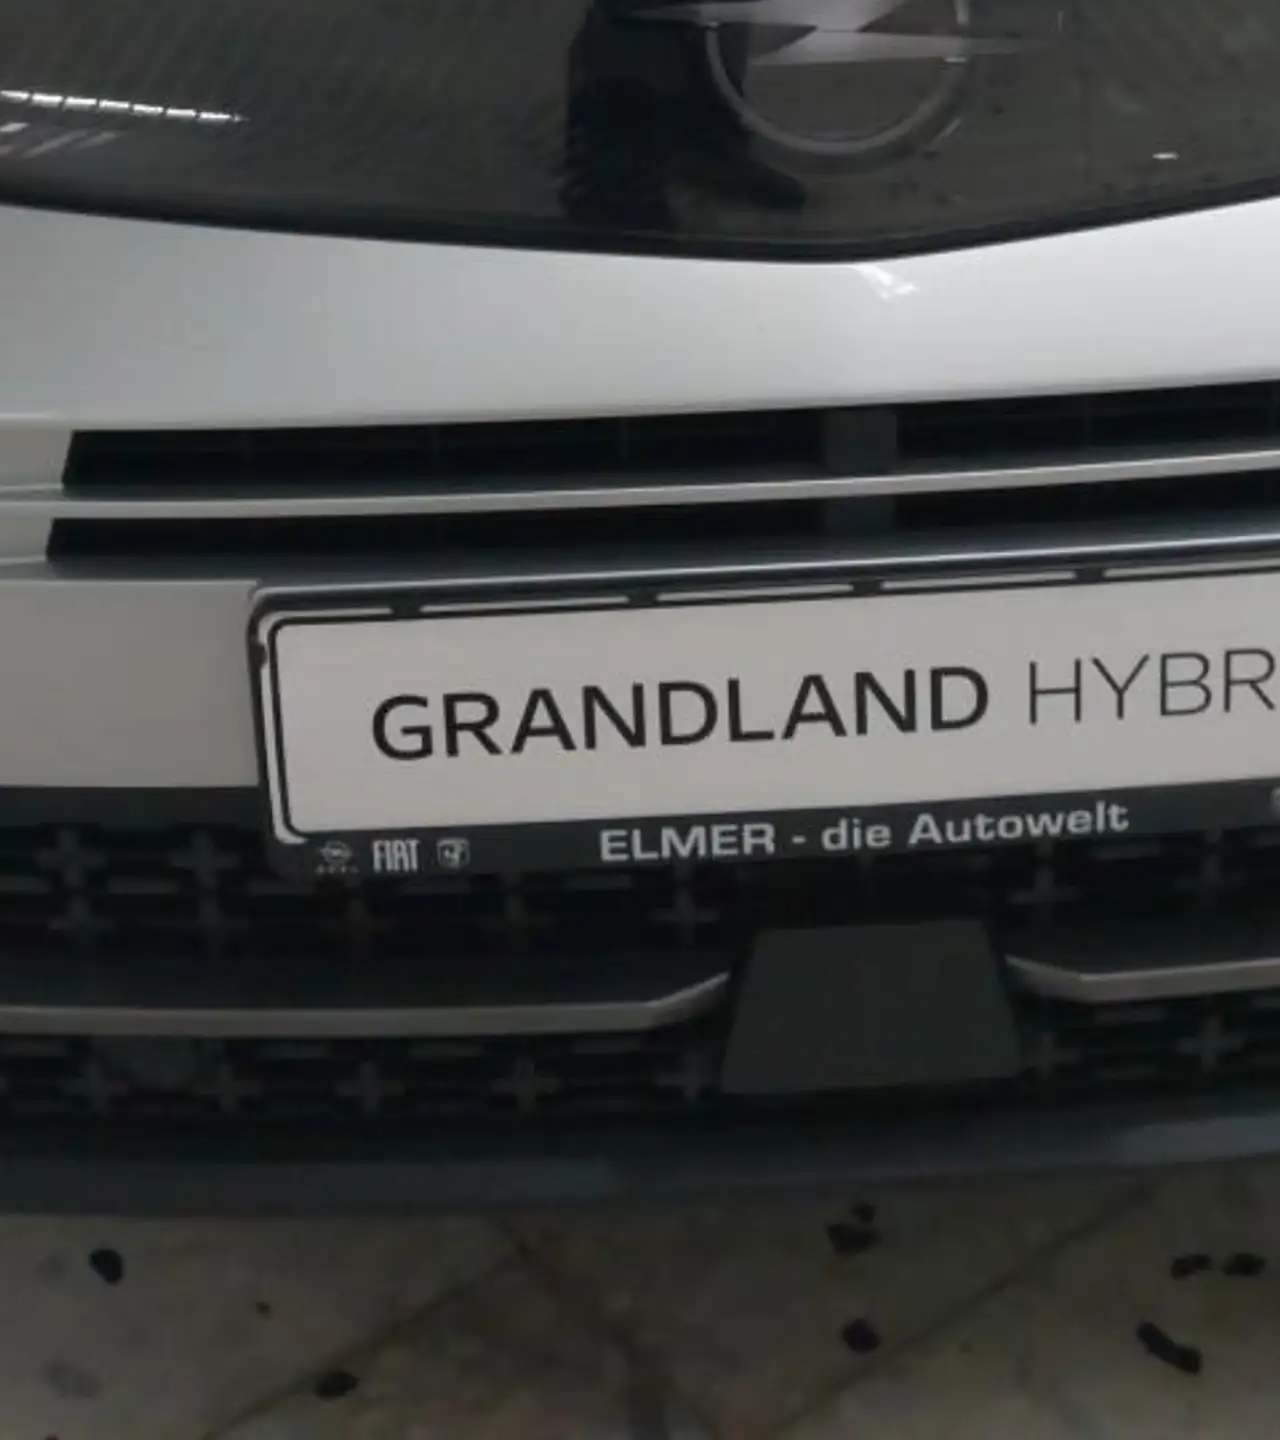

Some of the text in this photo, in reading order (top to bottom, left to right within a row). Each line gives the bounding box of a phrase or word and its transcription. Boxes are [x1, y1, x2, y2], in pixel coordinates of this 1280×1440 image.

[372, 665, 989, 761] GRANDLAND
[372, 839, 420, 874] FIAT
[600, 821, 776, 862] ELMER
[821, 818, 891, 852] die
[908, 800, 1130, 847] Autowelt
